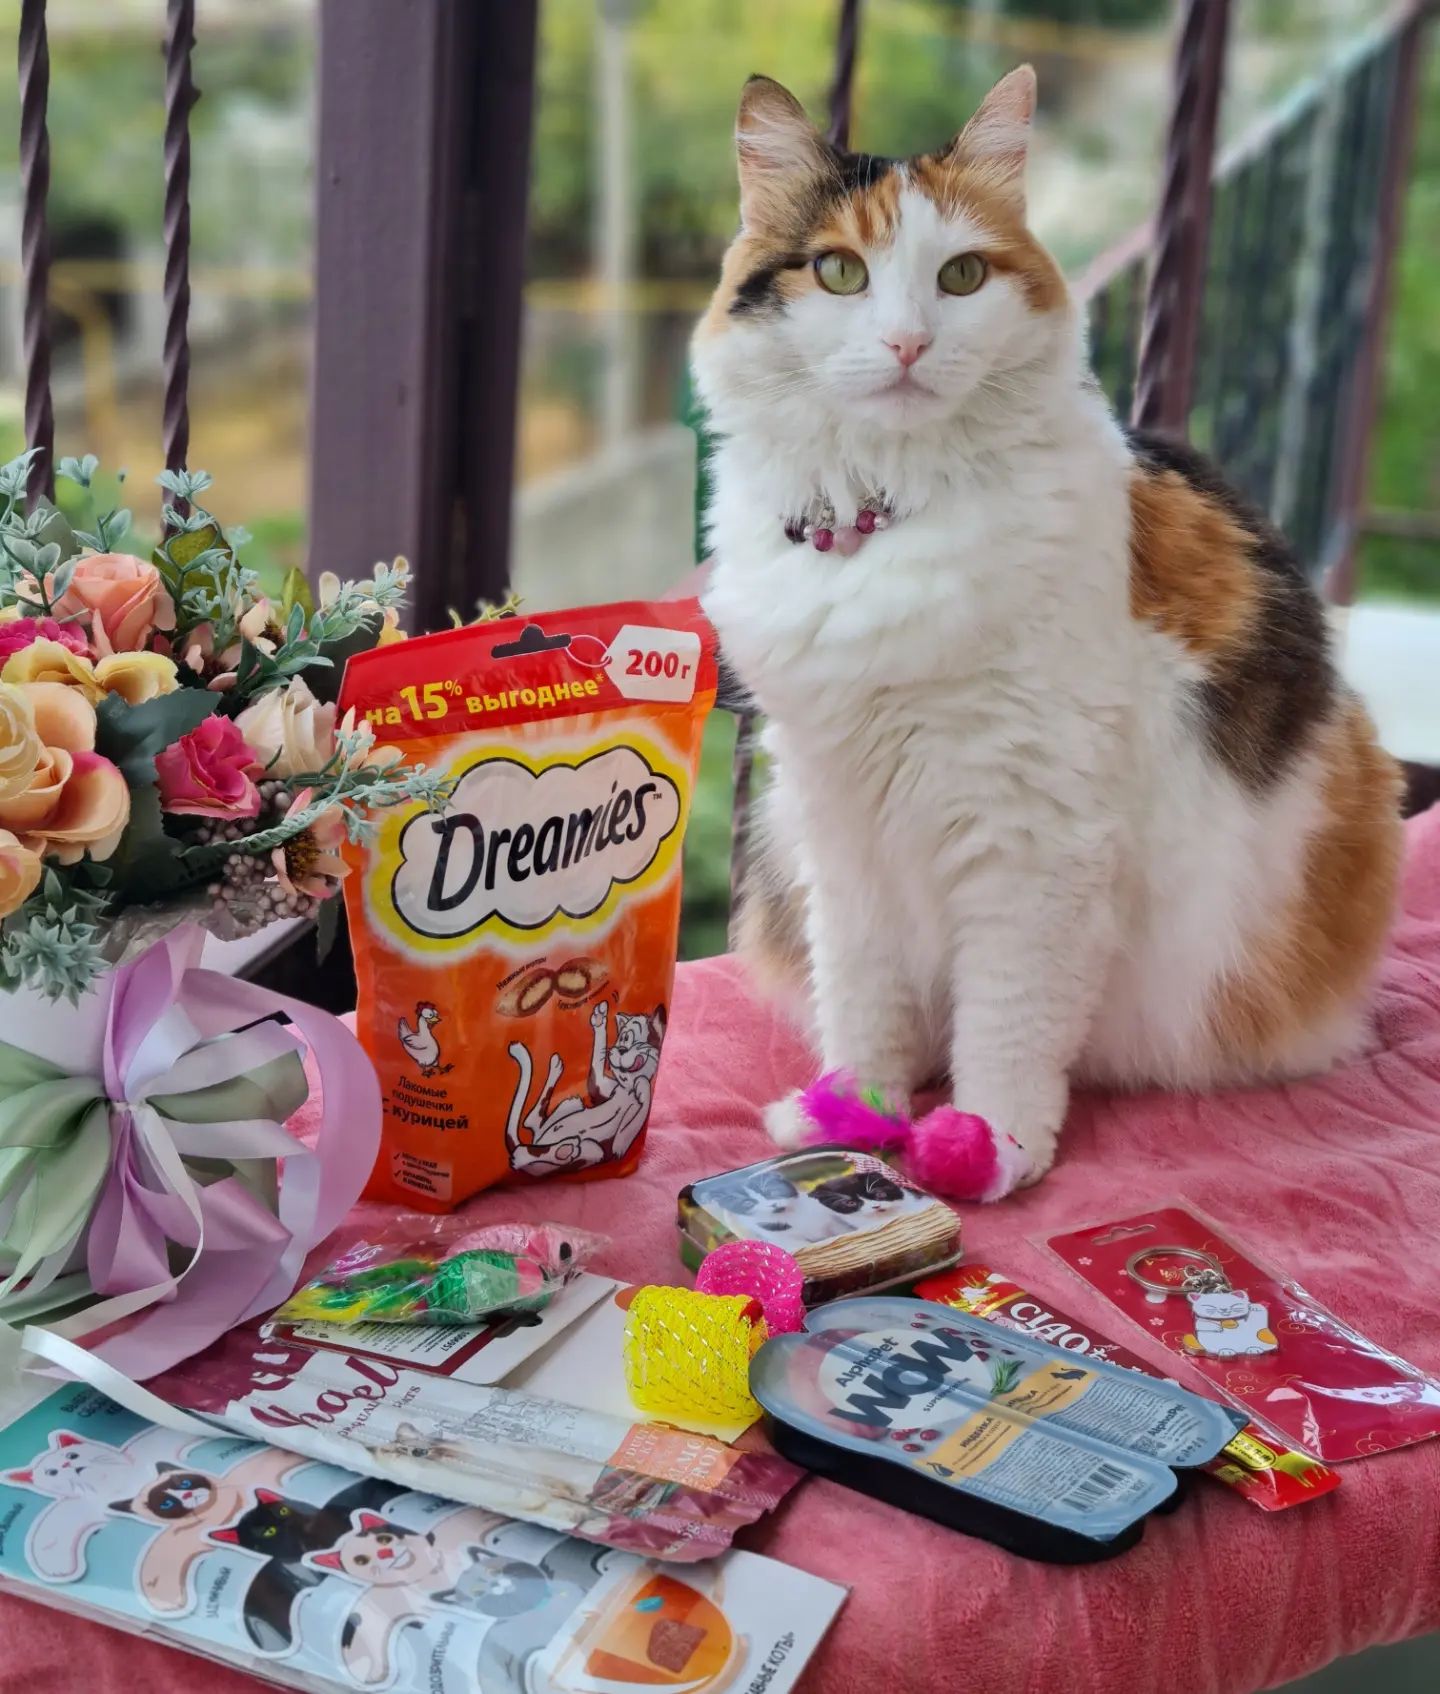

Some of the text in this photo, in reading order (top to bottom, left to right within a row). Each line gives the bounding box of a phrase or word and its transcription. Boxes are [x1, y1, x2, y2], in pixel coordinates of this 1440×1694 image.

[365, 708, 402, 728] на
[400, 679, 464, 722] 15%
[391, 1088, 454, 1113] подушечки
[398, 1075, 448, 1099] Лакомые
[391, 1104, 469, 1131] курицей
[1009, 1302, 1091, 1355] CIAO
[827, 1327, 975, 1428] WOW
[835, 1335, 900, 1388] AlphaPet
